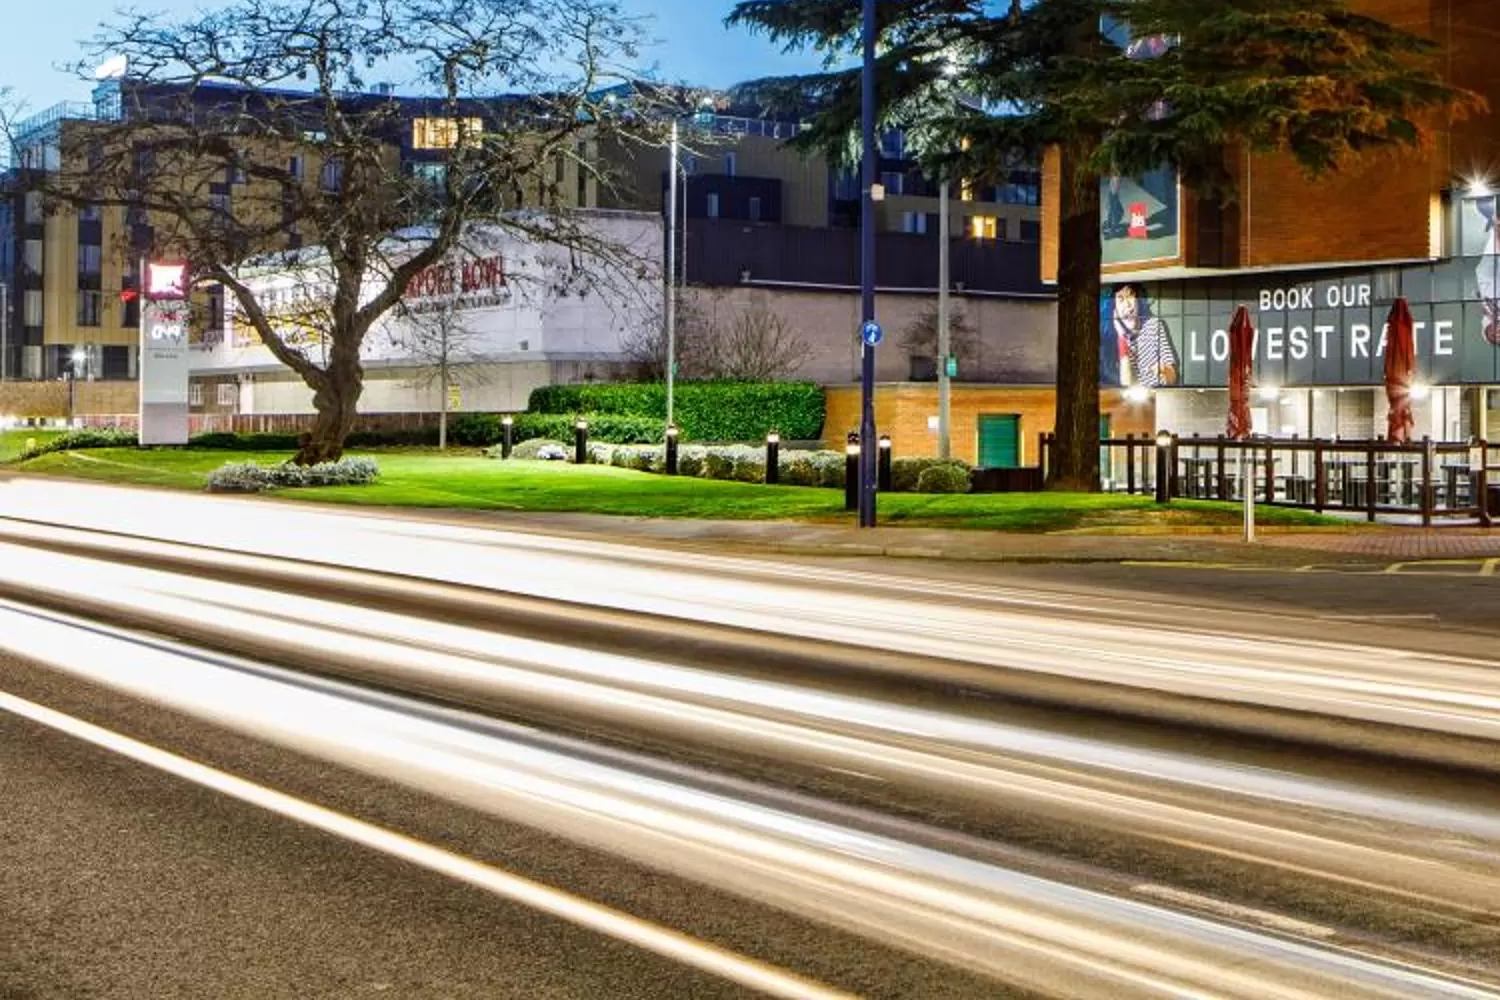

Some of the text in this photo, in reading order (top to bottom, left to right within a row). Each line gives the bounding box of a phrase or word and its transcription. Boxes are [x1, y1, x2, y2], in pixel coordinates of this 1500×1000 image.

[1259, 284, 1371, 311] BOOK OUR
[1190, 325, 1334, 361] LOEST
